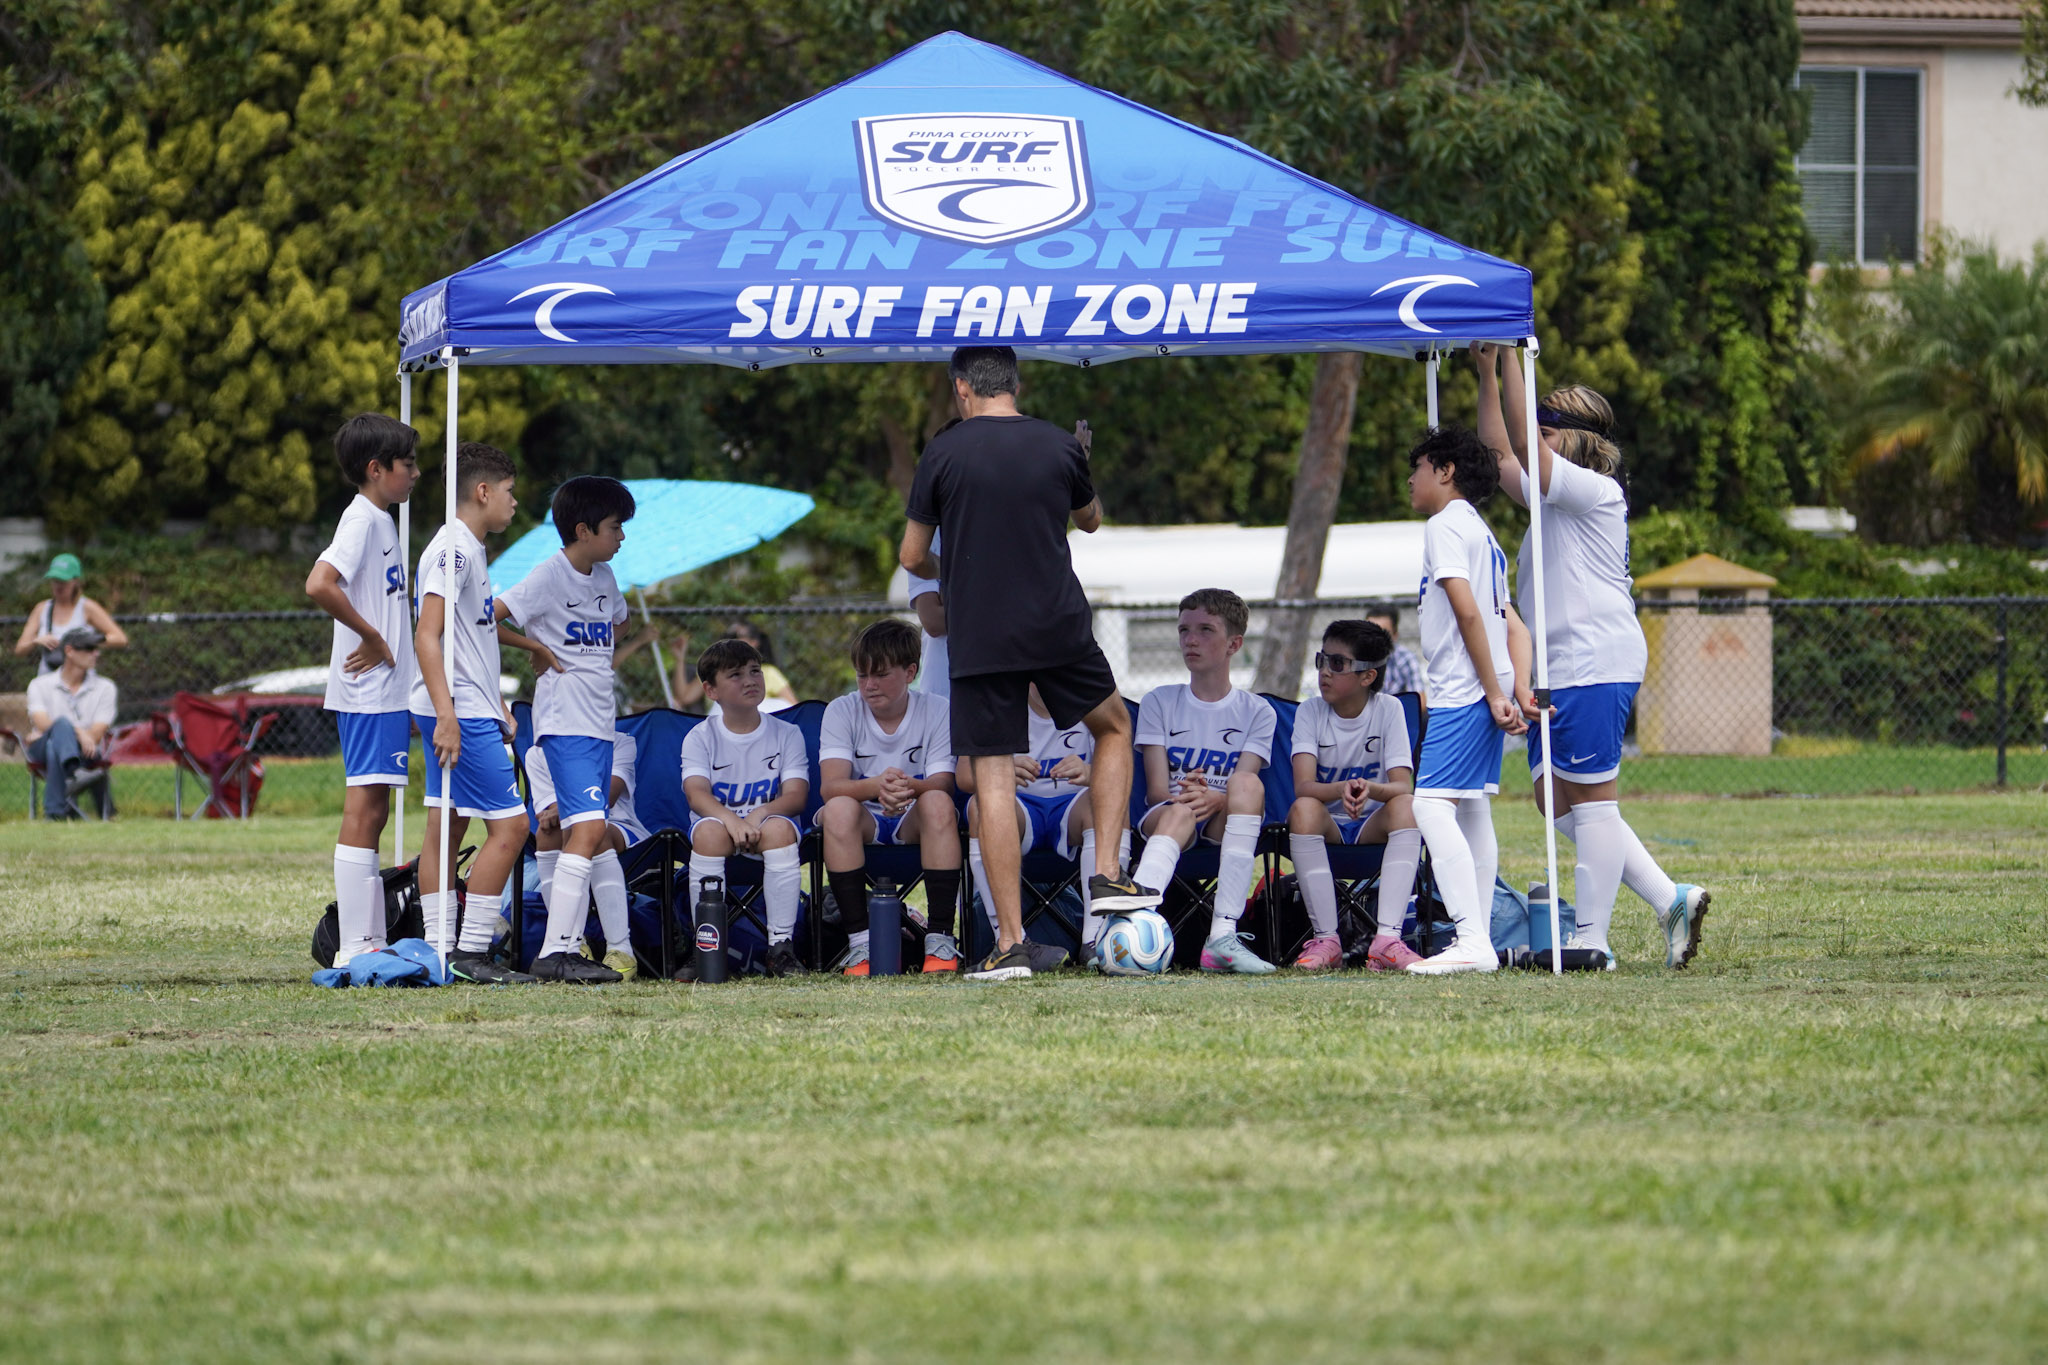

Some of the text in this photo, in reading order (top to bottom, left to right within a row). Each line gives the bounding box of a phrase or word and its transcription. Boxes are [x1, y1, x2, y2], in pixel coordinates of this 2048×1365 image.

[884, 141, 1059, 163] SURF
[717, 230, 922, 270] FAN
[1280, 222, 1466, 263] SUR
[728, 282, 1258, 339] SURF FAN ZONE
[1167, 746, 1242, 776] SURF
